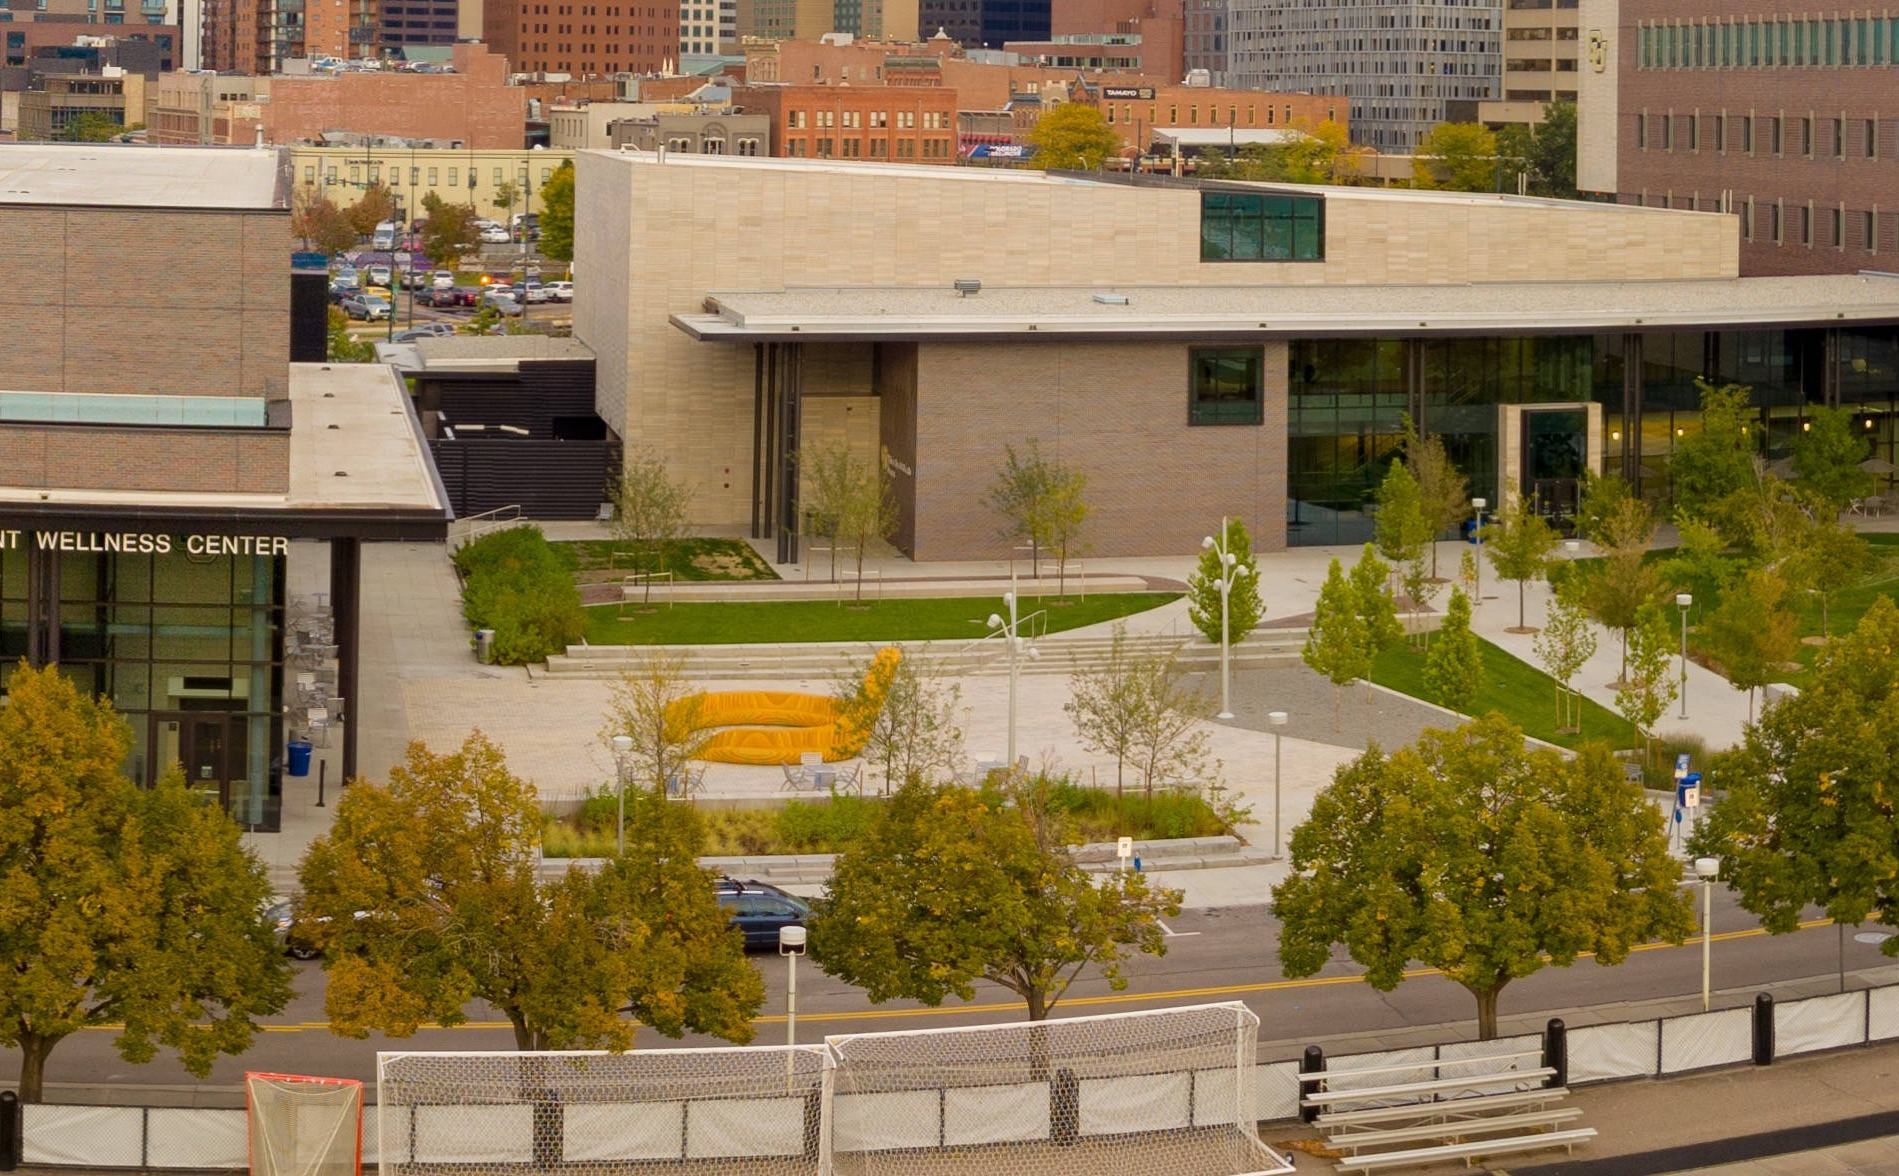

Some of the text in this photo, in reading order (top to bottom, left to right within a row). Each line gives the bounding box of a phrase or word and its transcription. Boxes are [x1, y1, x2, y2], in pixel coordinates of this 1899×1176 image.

[1106, 89, 1137, 97] TAMAYO
[36, 531, 171, 553] WELLNESS
[186, 535, 289, 556] CENTER
